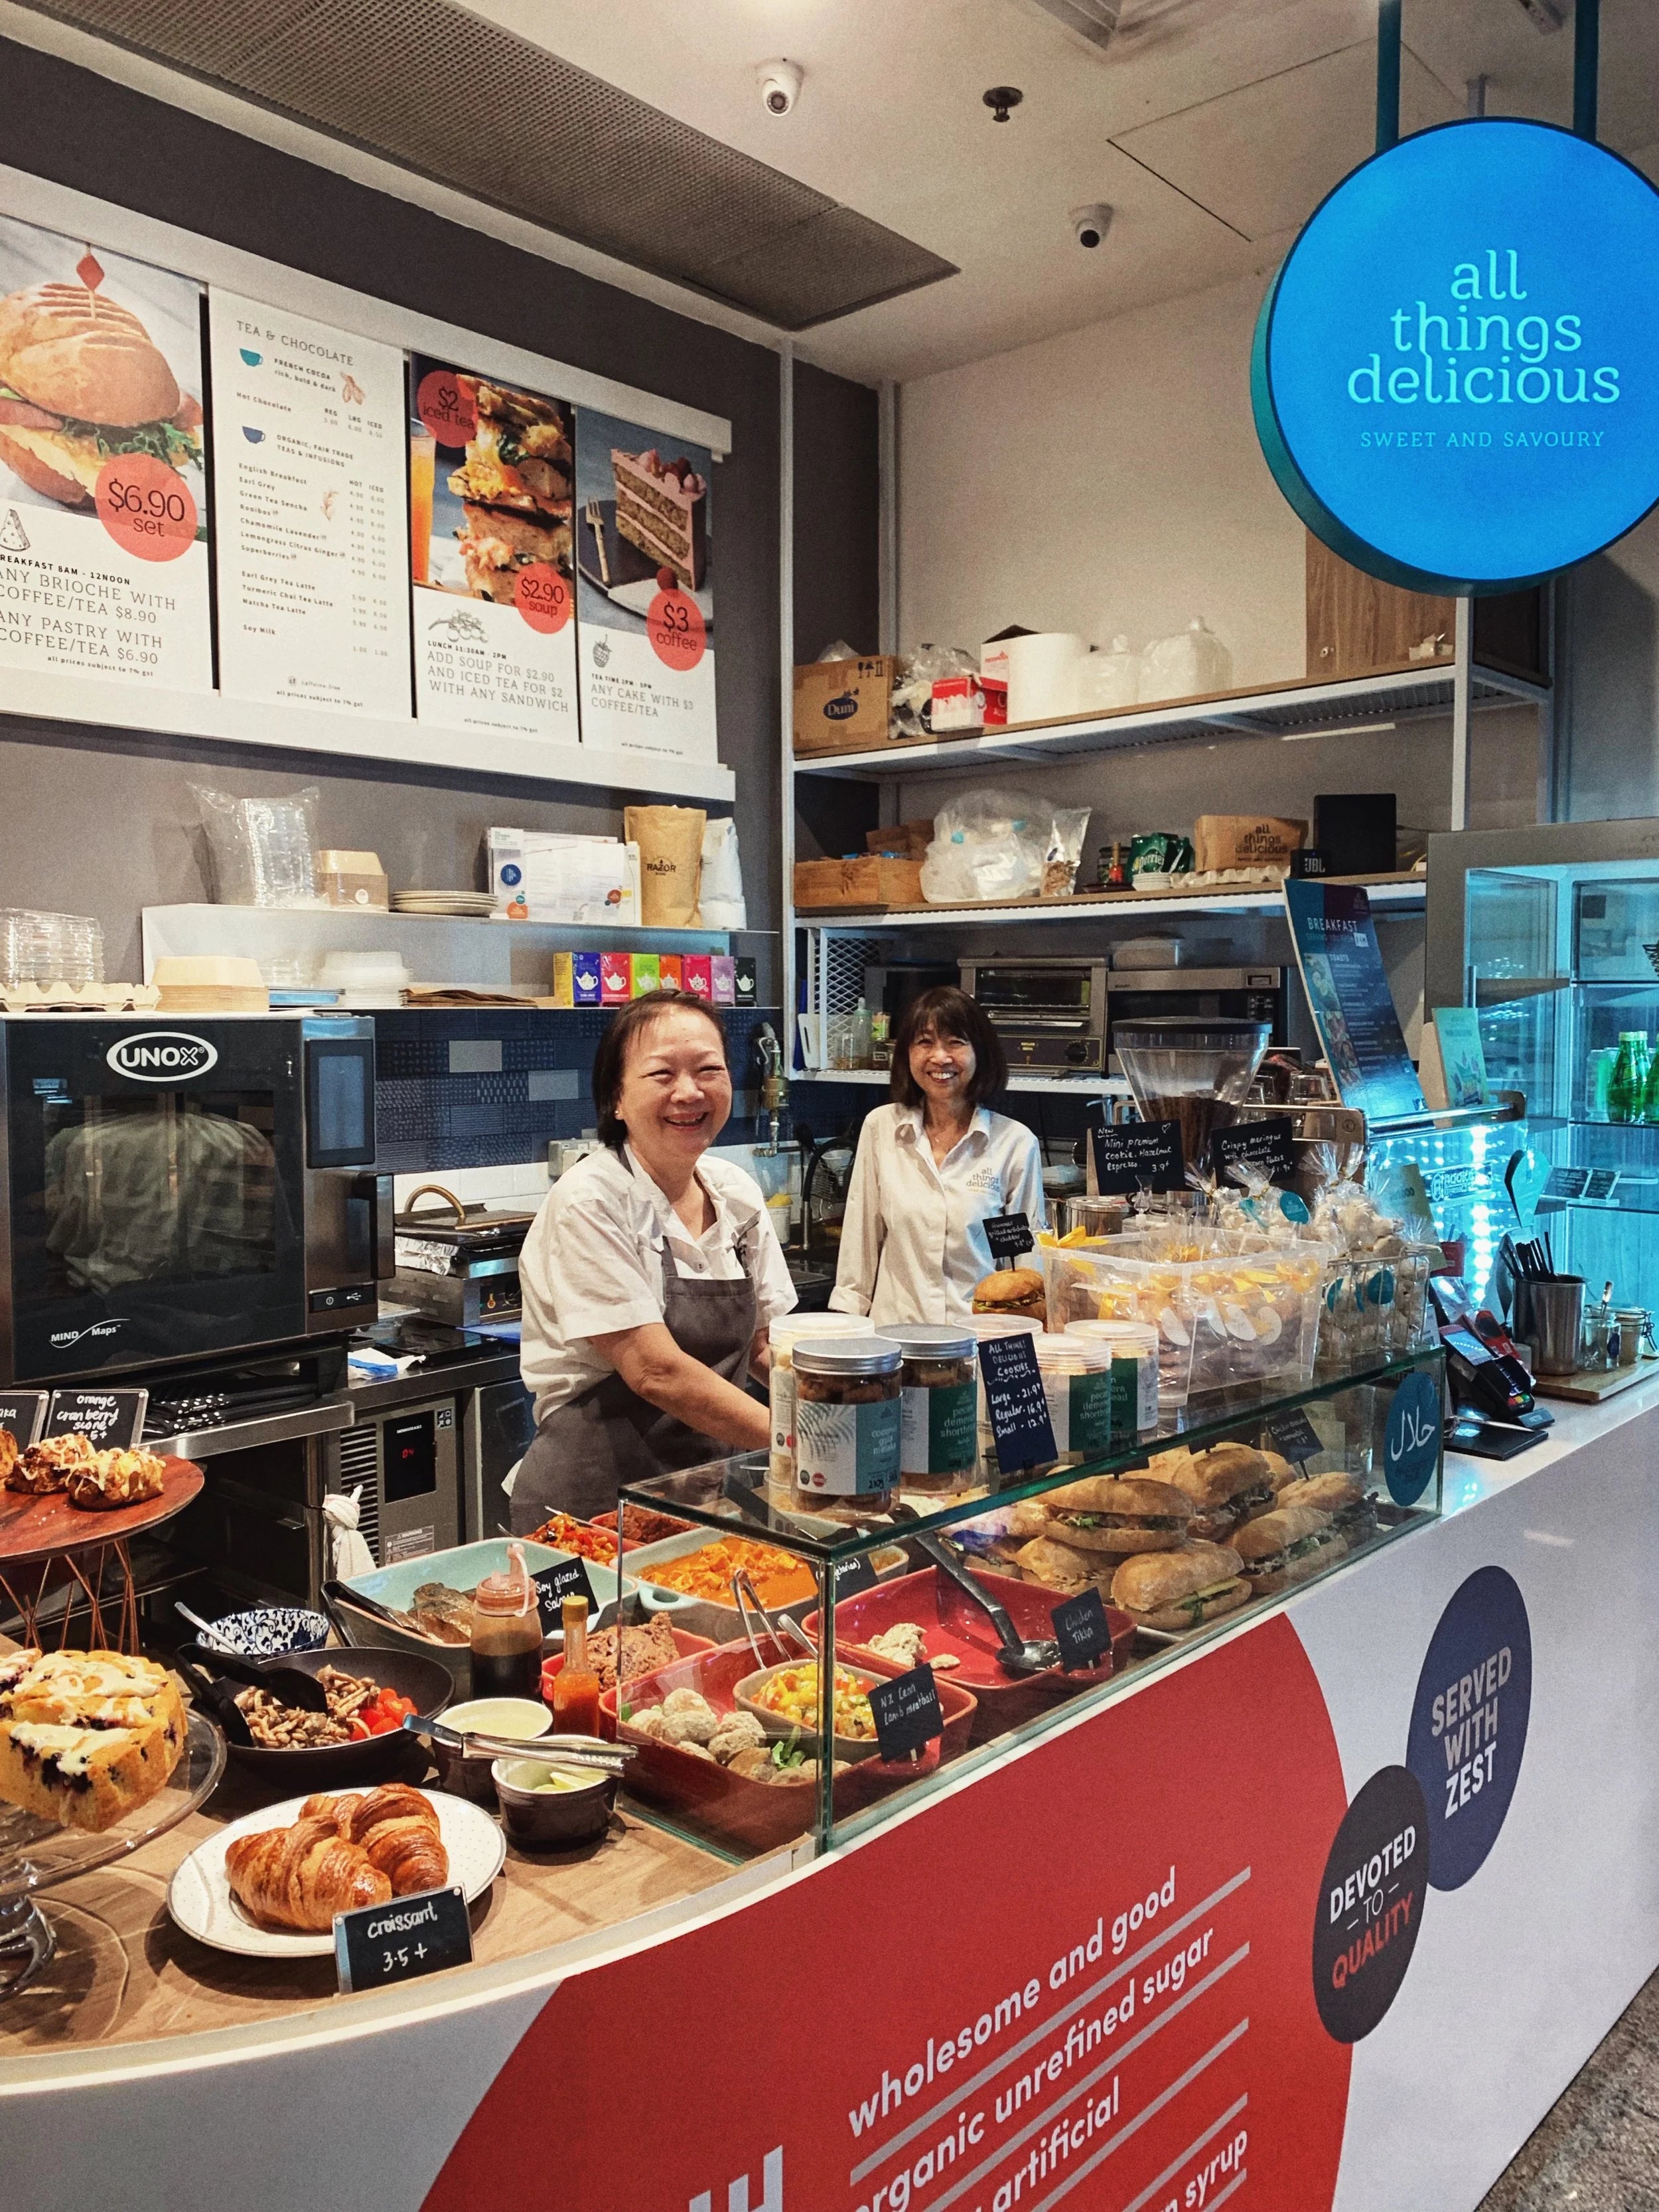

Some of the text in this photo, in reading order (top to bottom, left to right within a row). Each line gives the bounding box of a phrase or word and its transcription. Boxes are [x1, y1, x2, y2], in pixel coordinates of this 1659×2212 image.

[1450, 249, 1528, 301] all
[237, 321, 353, 366] TEA & CHOCOLATE
[1391, 301, 1582, 364] things
[274, 358, 330, 380] FRENCH COCOA
[1347, 354, 1621, 405] delicious
[237, 392, 291, 412] Hot Chocolate
[439, 386, 459, 411] $2
[423, 402, 474, 429] iced tea
[1360, 431, 1605, 447] SWEET AND SAVOURY
[277, 445, 295, 455] TEAS
[306, 453, 345, 467] INFUSIONS
[314, 445, 329, 453] FAIR
[332, 449, 354, 459] TRADE
[239, 463, 307, 484] English Breakfast
[257, 481, 275, 491] Grey
[108, 478, 185, 522] $6.90
[240, 490, 307, 511] Green Tea Sencha
[240, 504, 271, 516] Rooibos
[133, 517, 165, 538] set
[241, 518, 319, 540] Chamomile Lavender
[241, 532, 338, 558] Lemongrass Citrus Ginger
[242, 545, 289, 559] Superberries
[0, 553, 130, 586] REAKFAST 8AM 12NOON
[260, 575, 277, 584] Grey
[40, 570, 176, 611] BRIOCHE WITH
[242, 585, 277, 596] Turmeric
[280, 591, 296, 600] Chai
[314, 599, 333, 607] Latte
[521, 576, 564, 604] $2.90
[116, 606, 157, 624] $8.90
[243, 599, 269, 609] Matcha
[529, 601, 558, 617] soup
[664, 601, 689, 632] $3
[42, 617, 163, 648] PASTRY WITH
[656, 630, 697, 650] coffee
[117, 647, 159, 664] $6.90
[428, 640, 452, 650] LUNCH
[60, 658, 85, 667] prices
[88, 661, 116, 672] subject
[427, 650, 554, 682] ADD SOUP FOR $2.90
[428, 666, 563, 698] AND ICED TEA FOR $2
[429, 680, 569, 712] WITH ANY SANDWICH
[591, 684, 693, 710] ANY CAKE WITH $3
[591, 698, 658, 717] COFFEE/TEA
[828, 702, 855, 715] Duni
[1244, 834, 1281, 844] things
[1256, 824, 1269, 834] all
[646, 863, 676, 872] RAZOR
[1305, 857, 1326, 873] JBL
[1307, 917, 1356, 932] BREAKFAST
[1105, 1137, 1159, 1149] Mini premium
[1139, 1146, 1172, 1157] Hazelnut
[1222, 1140, 1247, 1151] Crispy
[50, 1331, 79, 1343] MIND
[989, 1343, 1002, 1354] ALL
[76, 1395, 117, 1410] orange
[991, 1393, 1011, 1406] Large
[56, 1408, 119, 1426] cranberry
[72, 1420, 108, 1431] scone
[997, 1422, 1016, 1438] Small
[1390, 1405, 1436, 1461] حلال
[536, 1568, 579, 1598] Soy glazed
[1066, 1609, 1094, 1631] Chicken
[881, 1684, 916, 1708] NZ Lean
[1431, 1646, 1512, 1737] SERVED
[884, 1706, 904, 1726] Lamb
[1444, 1696, 1498, 1771] WITH
[1445, 1742, 1497, 1820] ZEST
[1331, 1826, 1415, 1923] DEVOTED
[1363, 1889, 1384, 1923] TO
[367, 1901, 438, 1939] croissant
[1333, 1892, 1413, 1990] QUALITY
[848, 1865, 1177, 2138] wholesome and good
[994, 1928, 1214, 2124] unrefined sugar
[993, 2075, 1119, 2212] artificial
[1185, 2130, 1248, 2207] syrup
